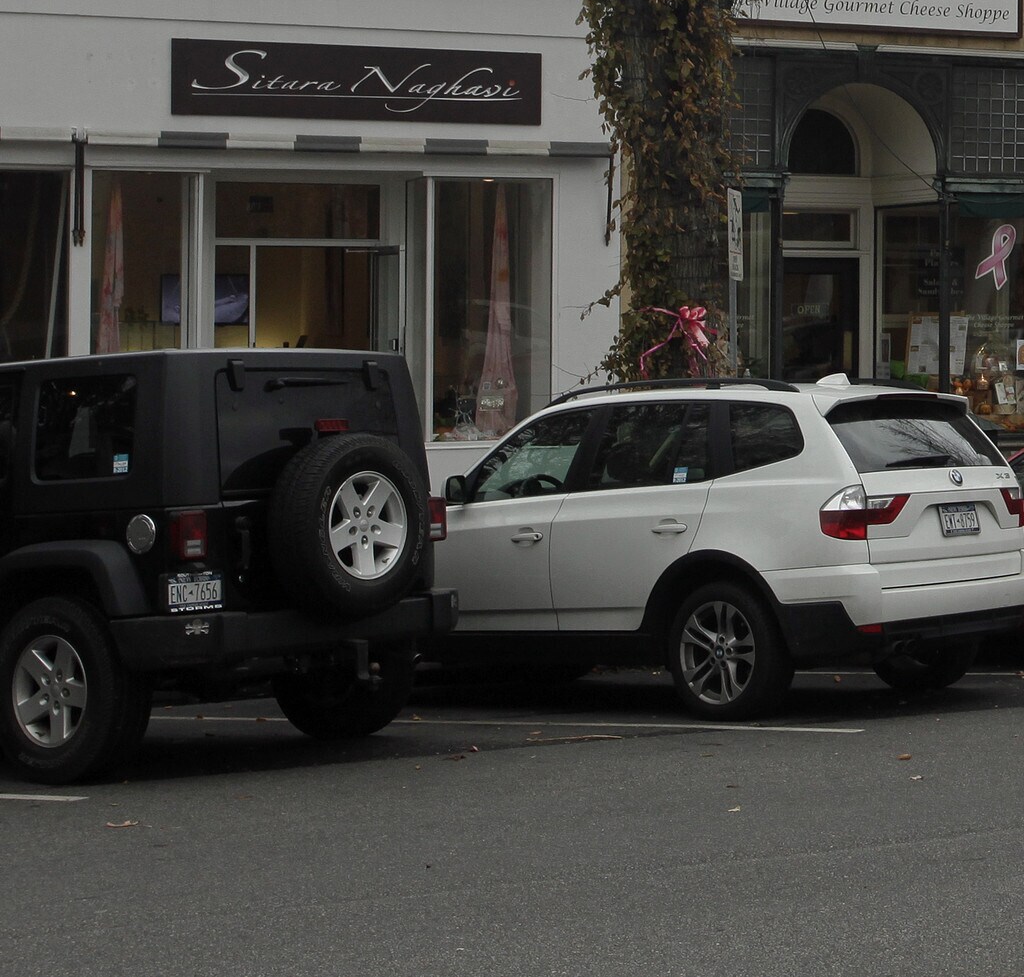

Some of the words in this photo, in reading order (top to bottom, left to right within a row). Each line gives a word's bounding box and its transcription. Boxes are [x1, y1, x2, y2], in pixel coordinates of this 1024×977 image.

[955, 2, 1010, 25] Shoppe
[192, 50, 342, 91] Sitara
[350, 63, 521, 113] Naghavi
[995, 472, 1010, 480] X3
[170, 584, 188, 603] ENC
[195, 582, 218, 602] 7656
